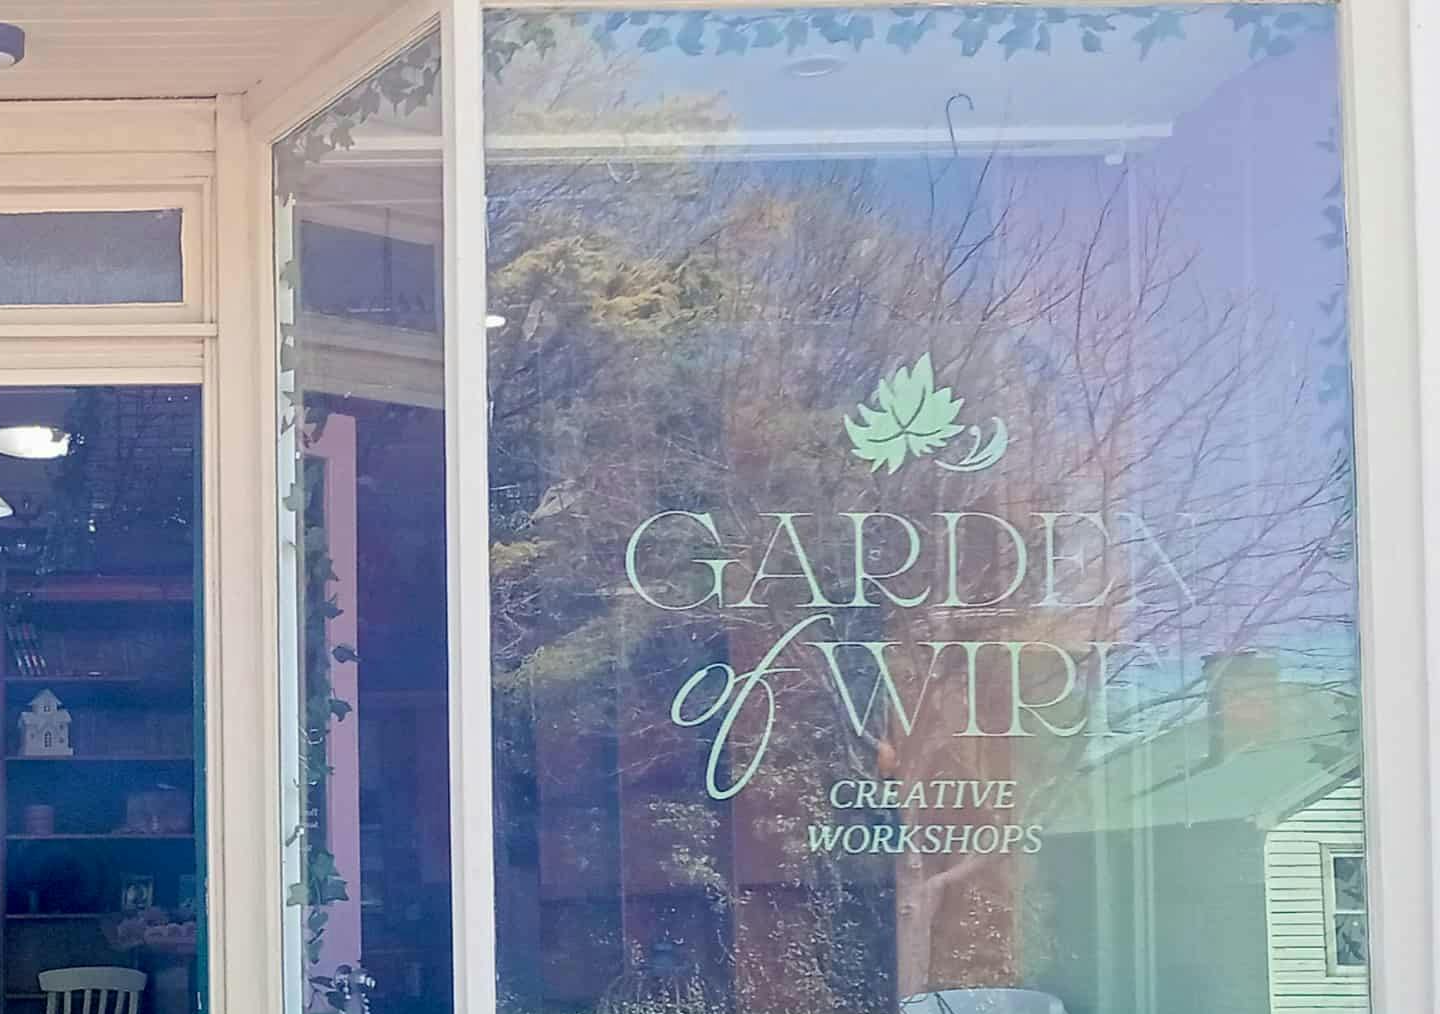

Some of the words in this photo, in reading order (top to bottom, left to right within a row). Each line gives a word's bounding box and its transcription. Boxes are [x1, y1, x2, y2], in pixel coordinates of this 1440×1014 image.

[624, 510, 1210, 610] GARDEN
[670, 614, 835, 800] of
[800, 640, 1172, 737] WIRE
[829, 779, 1017, 811] CREATIVE
[806, 823, 1044, 855] WORKSHOPS
